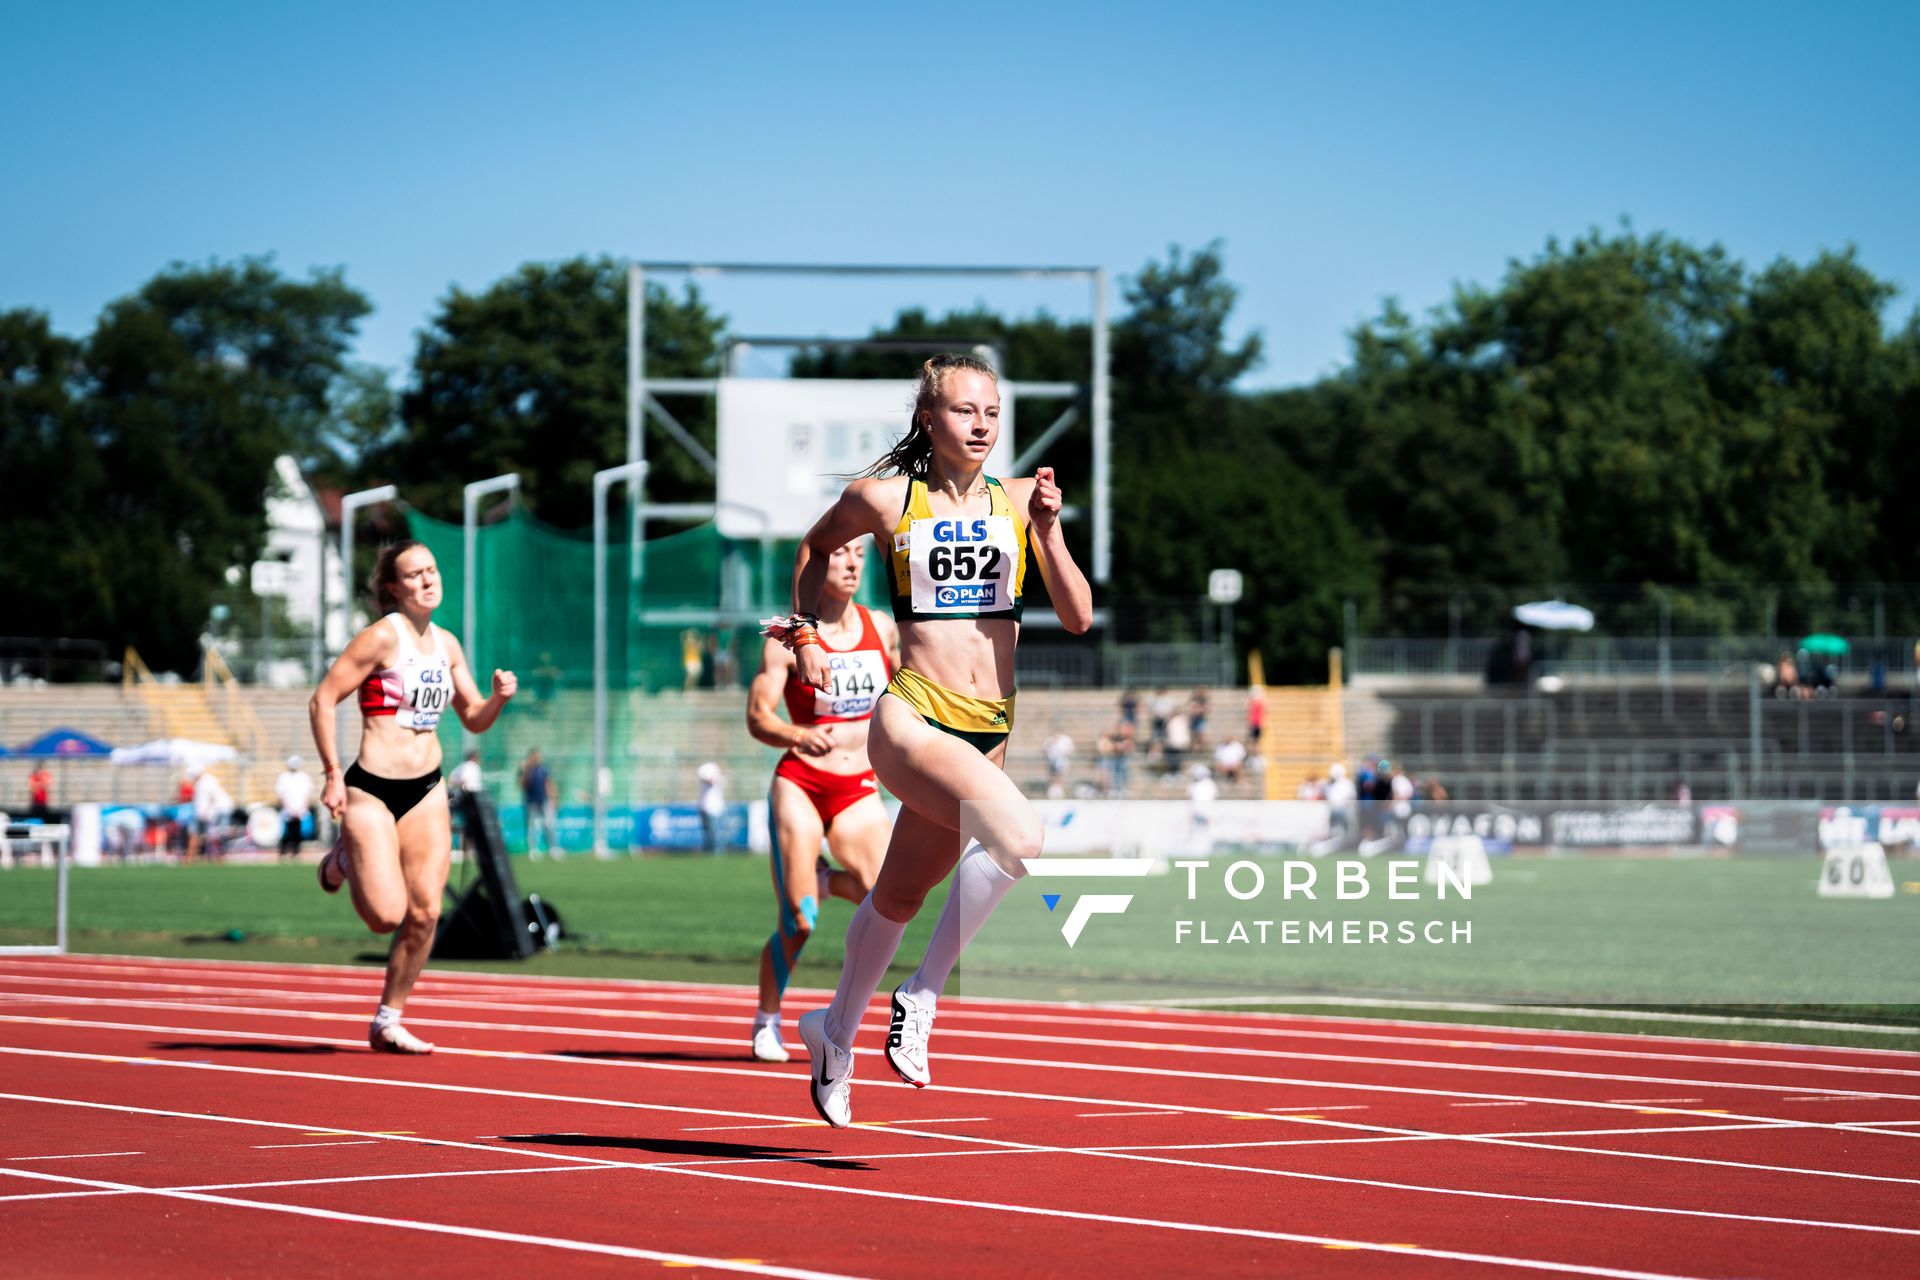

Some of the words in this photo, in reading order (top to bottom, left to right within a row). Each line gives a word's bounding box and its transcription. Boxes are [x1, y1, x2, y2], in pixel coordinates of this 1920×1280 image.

[933, 520, 988, 542] GLS
[929, 546, 1001, 581] 652
[961, 588, 993, 598] PLAN
[830, 656, 862, 670] GLS
[420, 670, 443, 683] GLS
[832, 673, 875, 696] 144
[410, 687, 449, 709] 1001
[1827, 857, 1864, 885] 60
